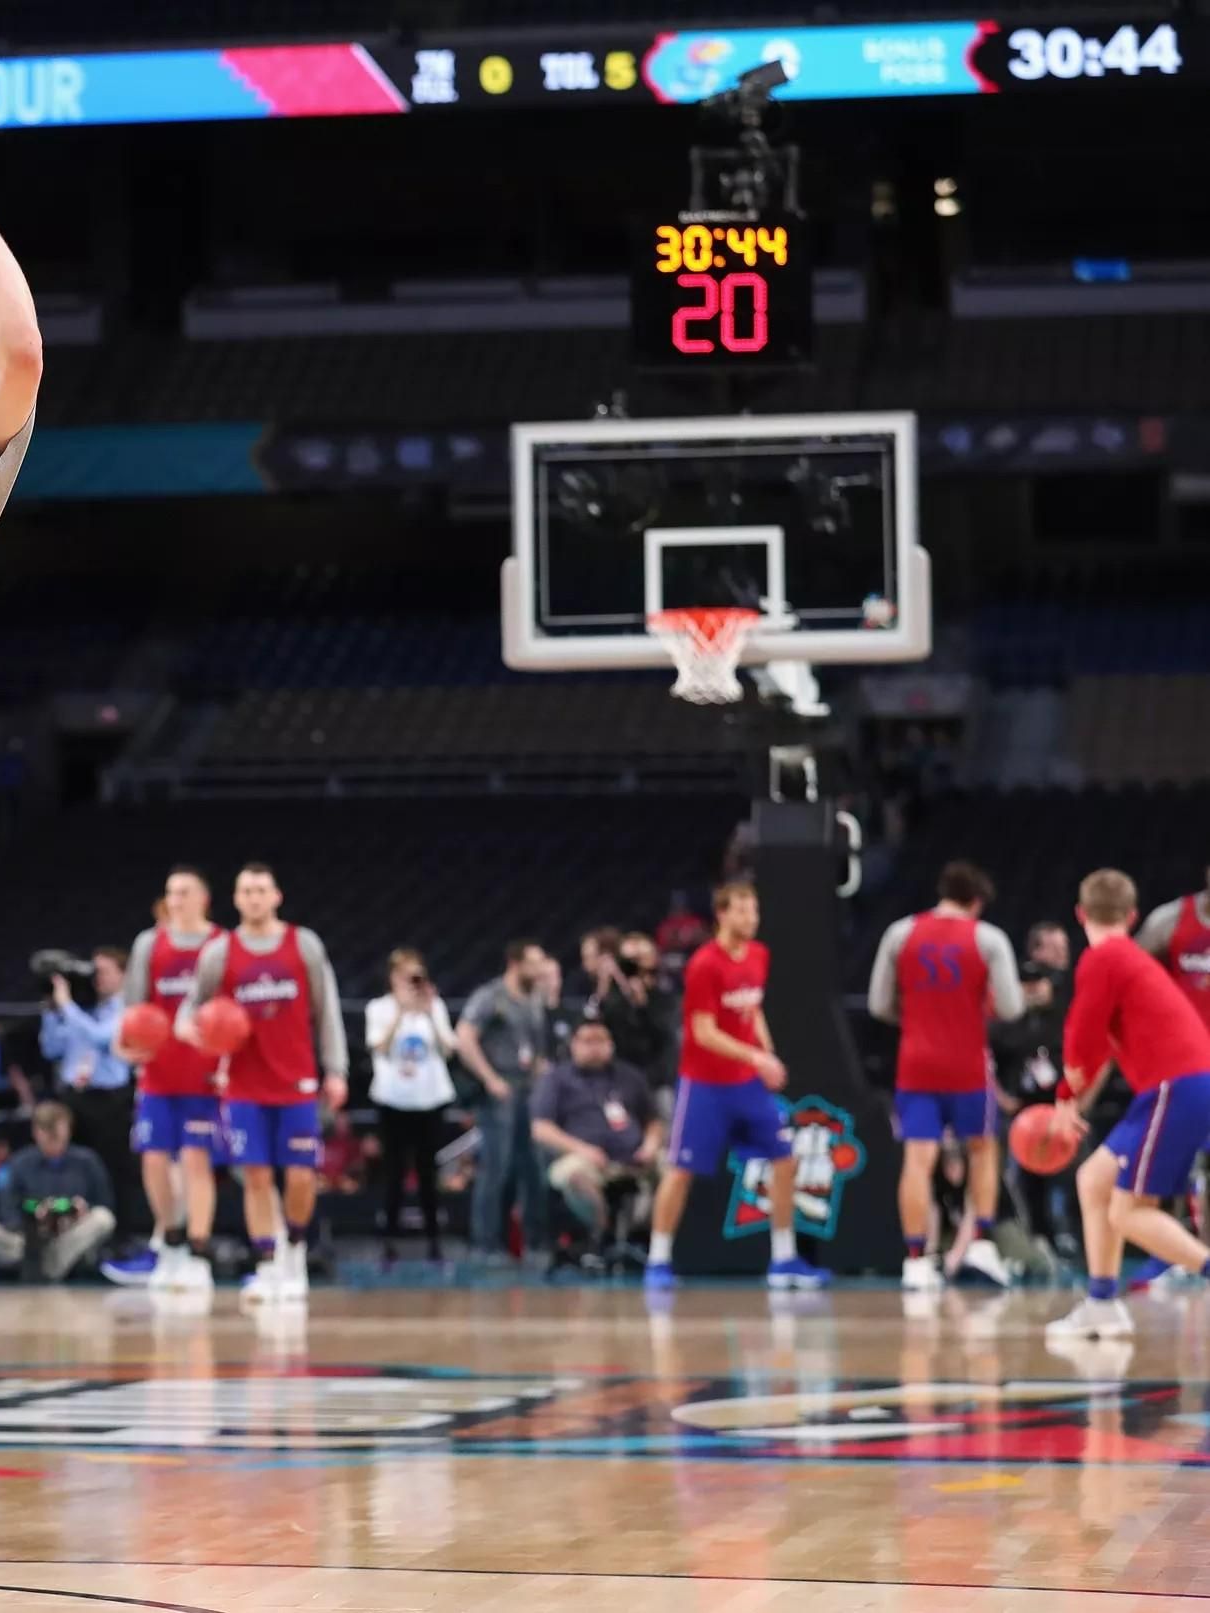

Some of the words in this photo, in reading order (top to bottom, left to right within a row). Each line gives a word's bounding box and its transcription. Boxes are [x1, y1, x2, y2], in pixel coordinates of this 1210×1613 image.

[478, 55, 513, 94] 0
[604, 51, 637, 91] 5
[1007, 23, 1183, 80] 30:44
[656, 224, 788, 273] 30:44
[672, 272, 768, 353] 20
